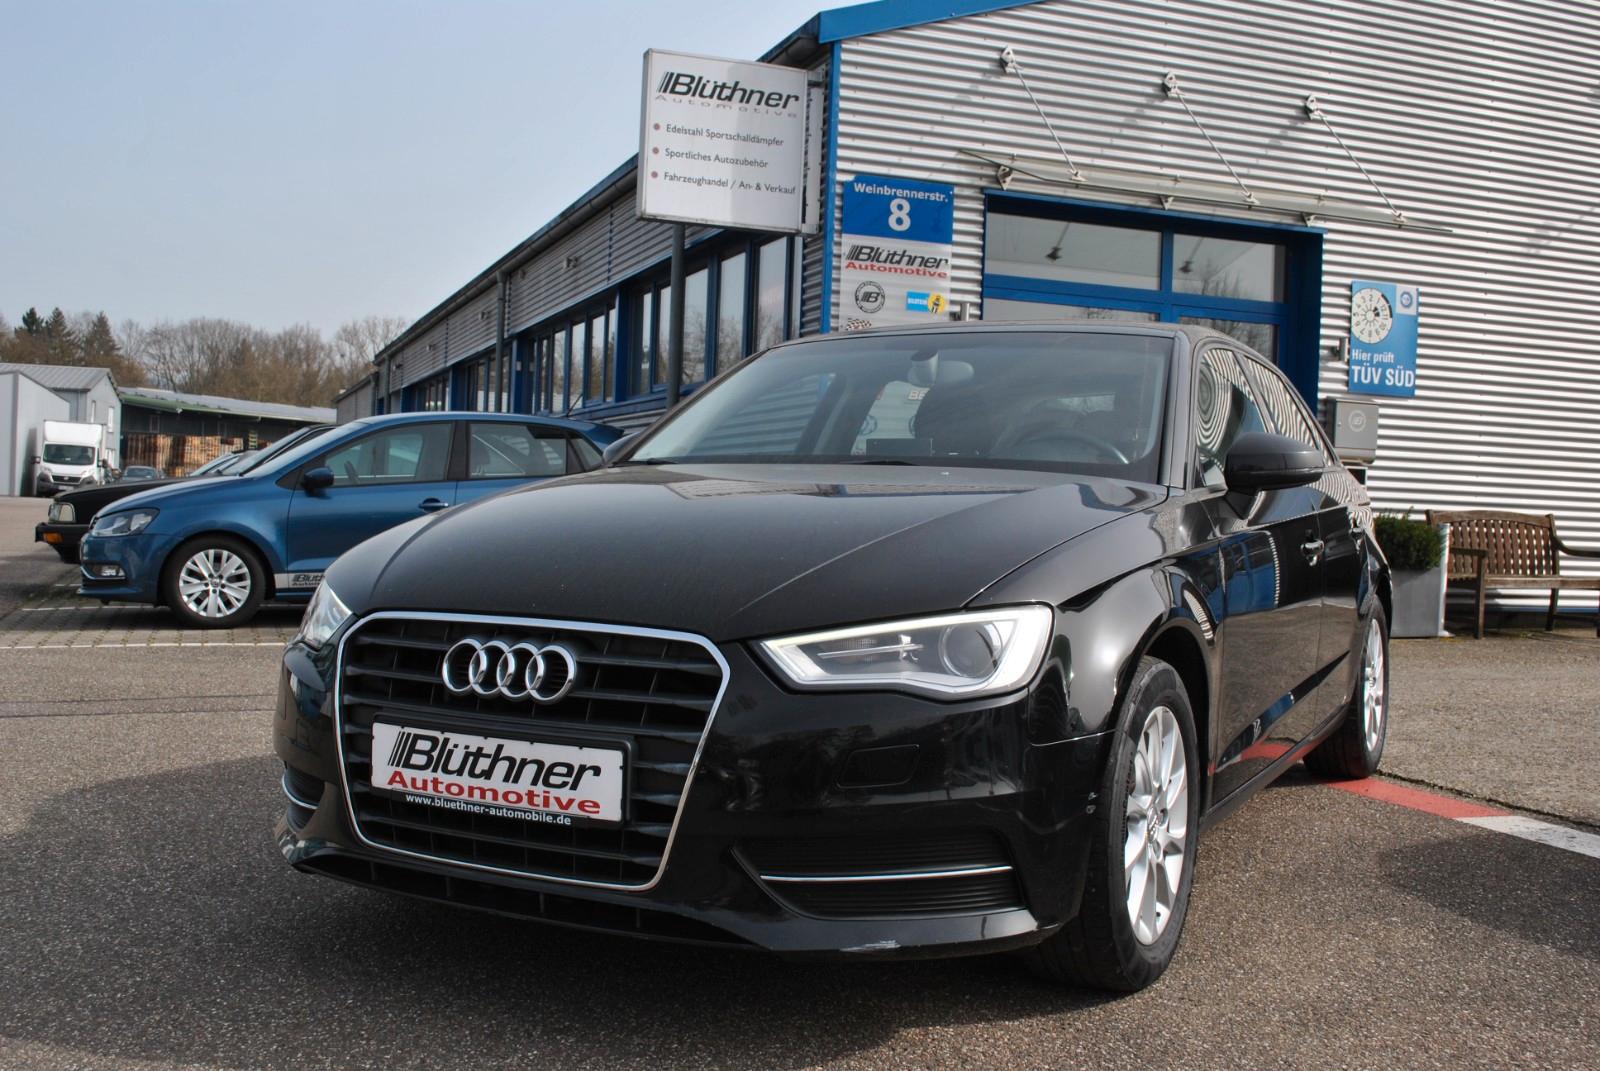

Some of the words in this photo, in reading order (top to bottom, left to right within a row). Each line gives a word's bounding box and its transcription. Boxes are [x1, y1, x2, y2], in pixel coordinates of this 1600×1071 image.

[658, 72, 800, 109] Blüthner
[655, 94, 798, 118] Automotive
[666, 124, 703, 137] Edelstahl
[705, 128, 784, 147] Sportschalldämpfer
[664, 147, 712, 163] Sportliches
[713, 153, 769, 168] Autozubehör
[664, 171, 729, 188] Fahrzeughandel
[755, 182, 762, 191] &
[764, 184, 796, 195] Verkauf
[853, 182, 949, 203] Weinbrennerstr.
[888, 198, 911, 232] 8
[847, 245, 950, 269] Blüthner
[845, 261, 948, 279] Automotive
[1352, 349, 1371, 361] Hier
[1373, 352, 1395, 364] prüft
[1351, 362, 1382, 384] TÜV
[1385, 365, 1415, 388] SÜD
[388, 731, 602, 791] Blüthner
[387, 770, 601, 815] Automotive
[405, 793, 572, 826] www.bluethner-automobile.de
